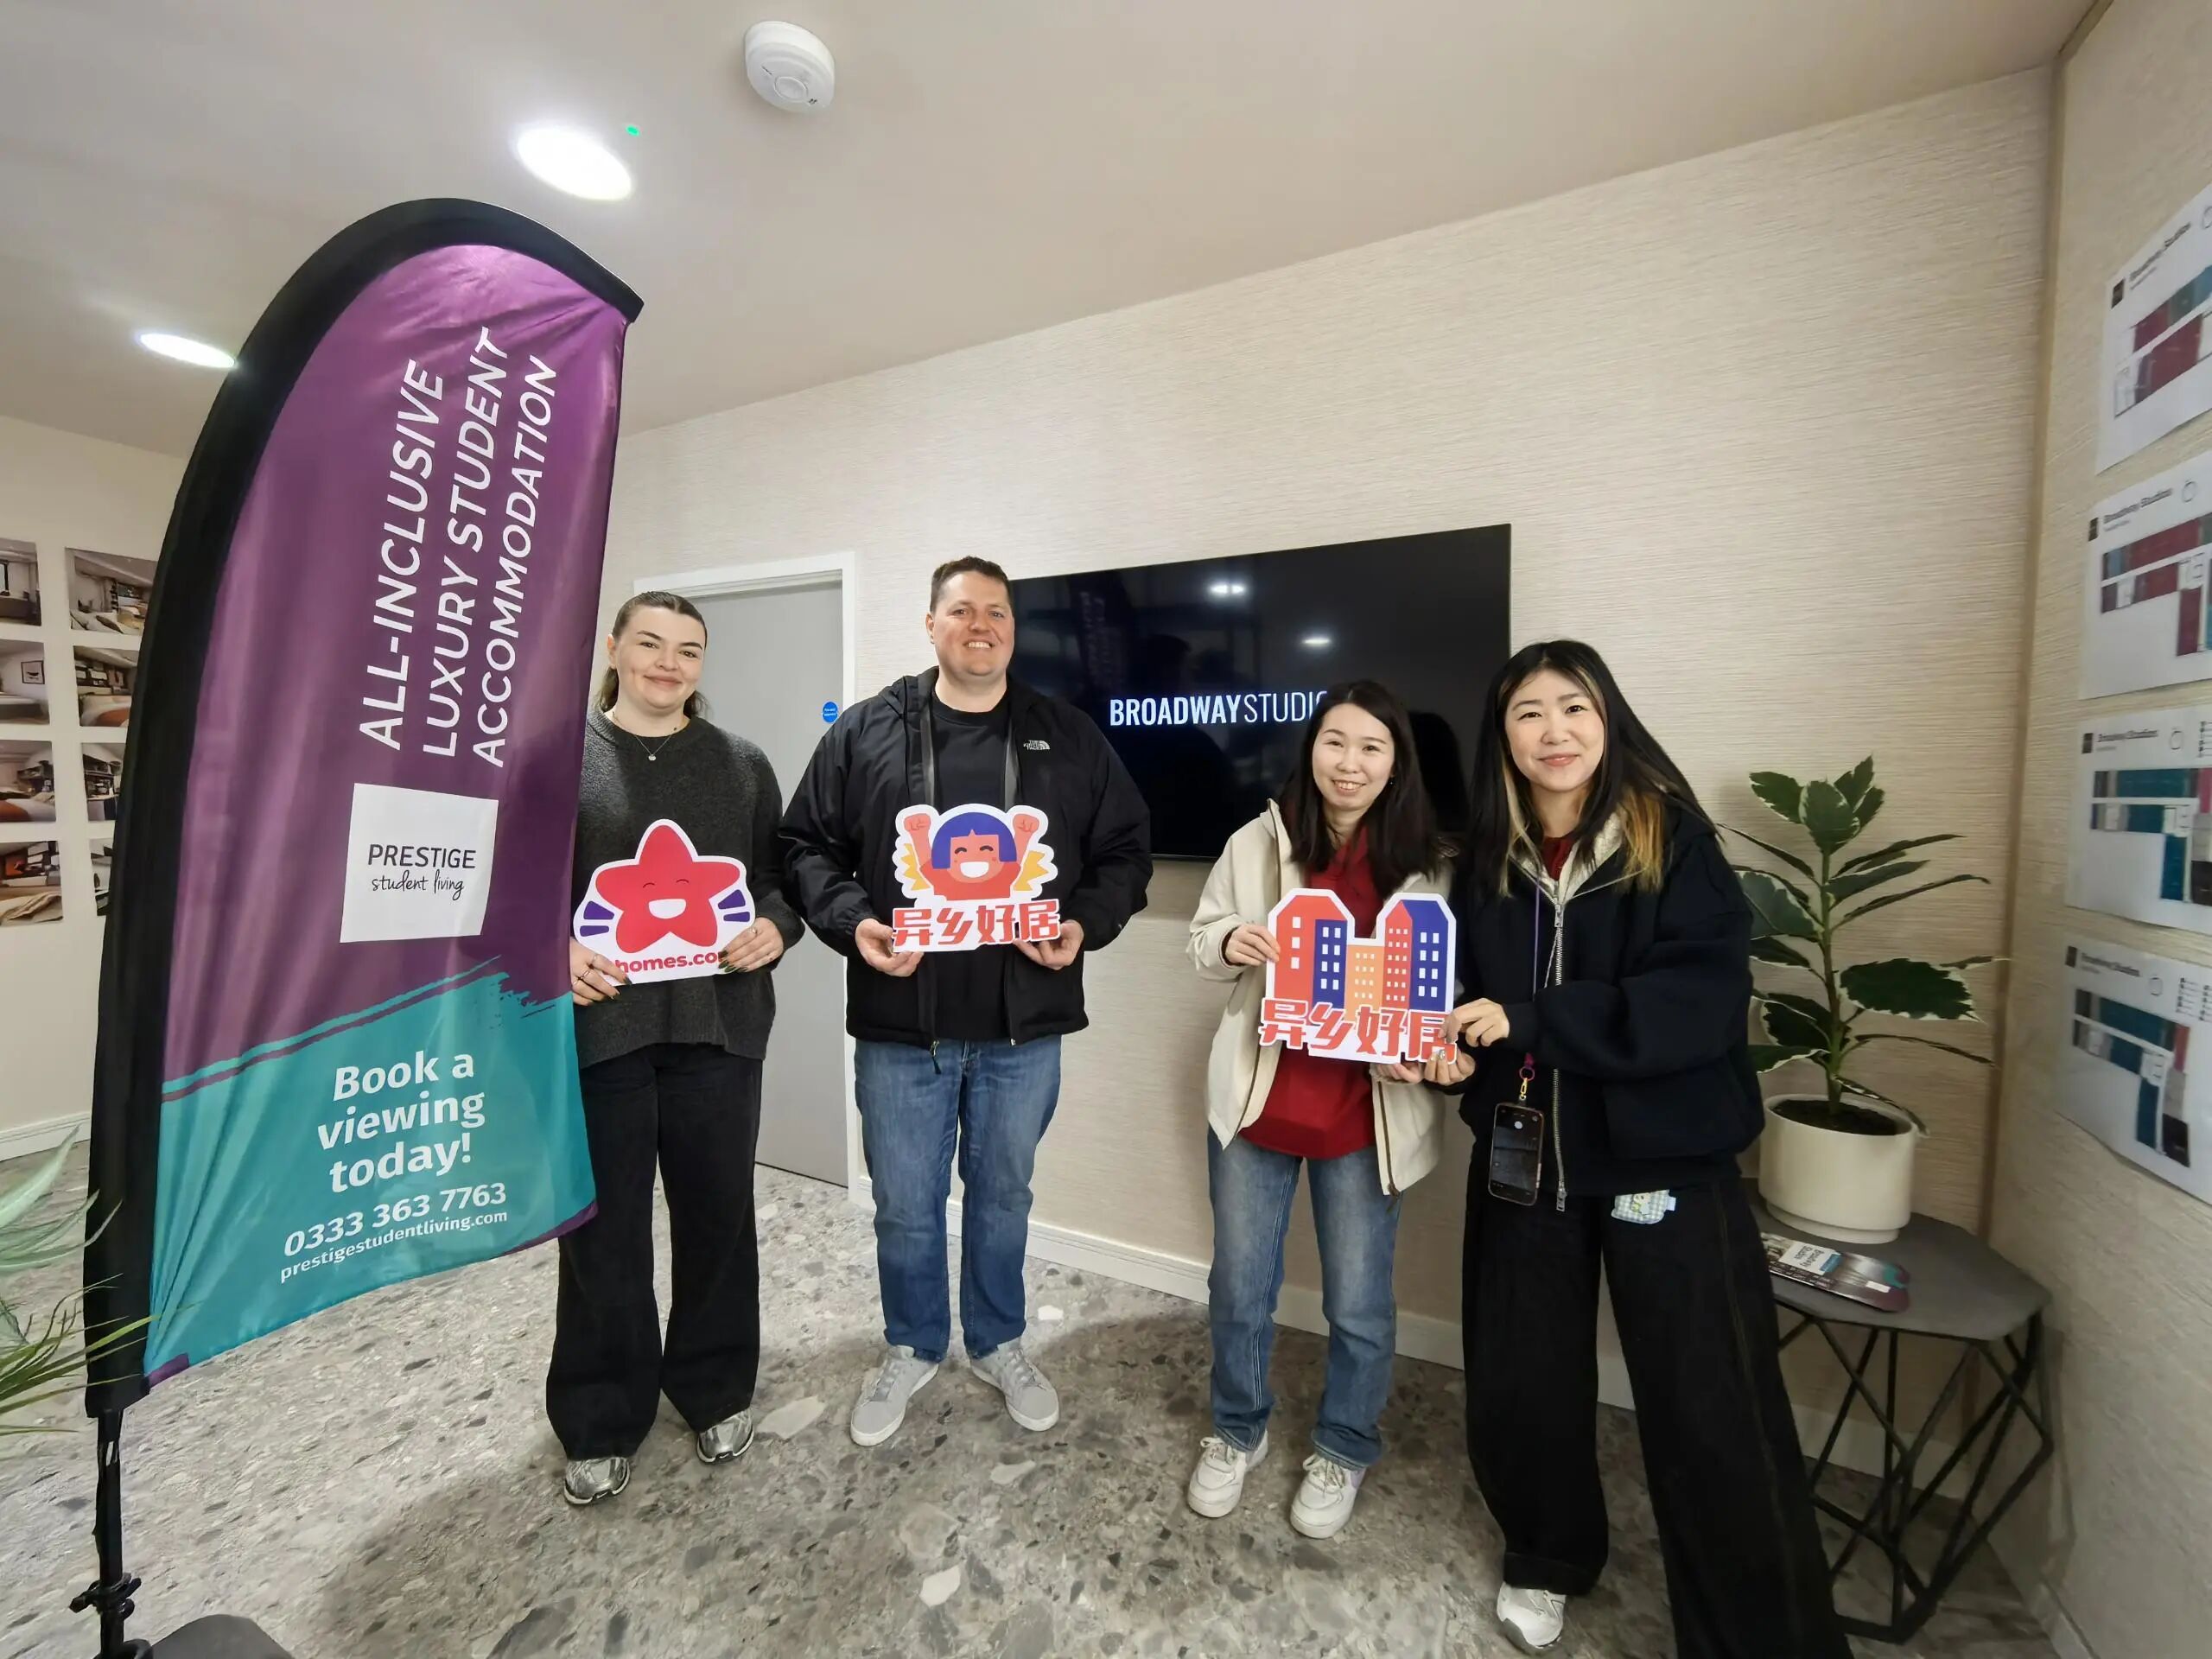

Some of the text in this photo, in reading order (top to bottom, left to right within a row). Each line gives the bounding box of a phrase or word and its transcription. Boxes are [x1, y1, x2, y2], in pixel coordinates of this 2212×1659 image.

[359, 359, 442, 750] ALL-INCLUSIVE
[423, 326, 508, 757] LUXURY STUDENT
[473, 354, 556, 767] ACCOMMODATION
[367, 843, 476, 869] PRESTIGE
[372, 868, 465, 901] student living
[892, 899, 1060, 947] 异乡好居
[605, 951, 727, 975] homes.co
[333, 1050, 474, 1102] Book a
[317, 1090, 486, 1150] viewing
[329, 1132, 471, 1193] today!
[280, 1211, 507, 1284] prestigestudentliving.com
[283, 1182, 506, 1257] 0333 363 7763
